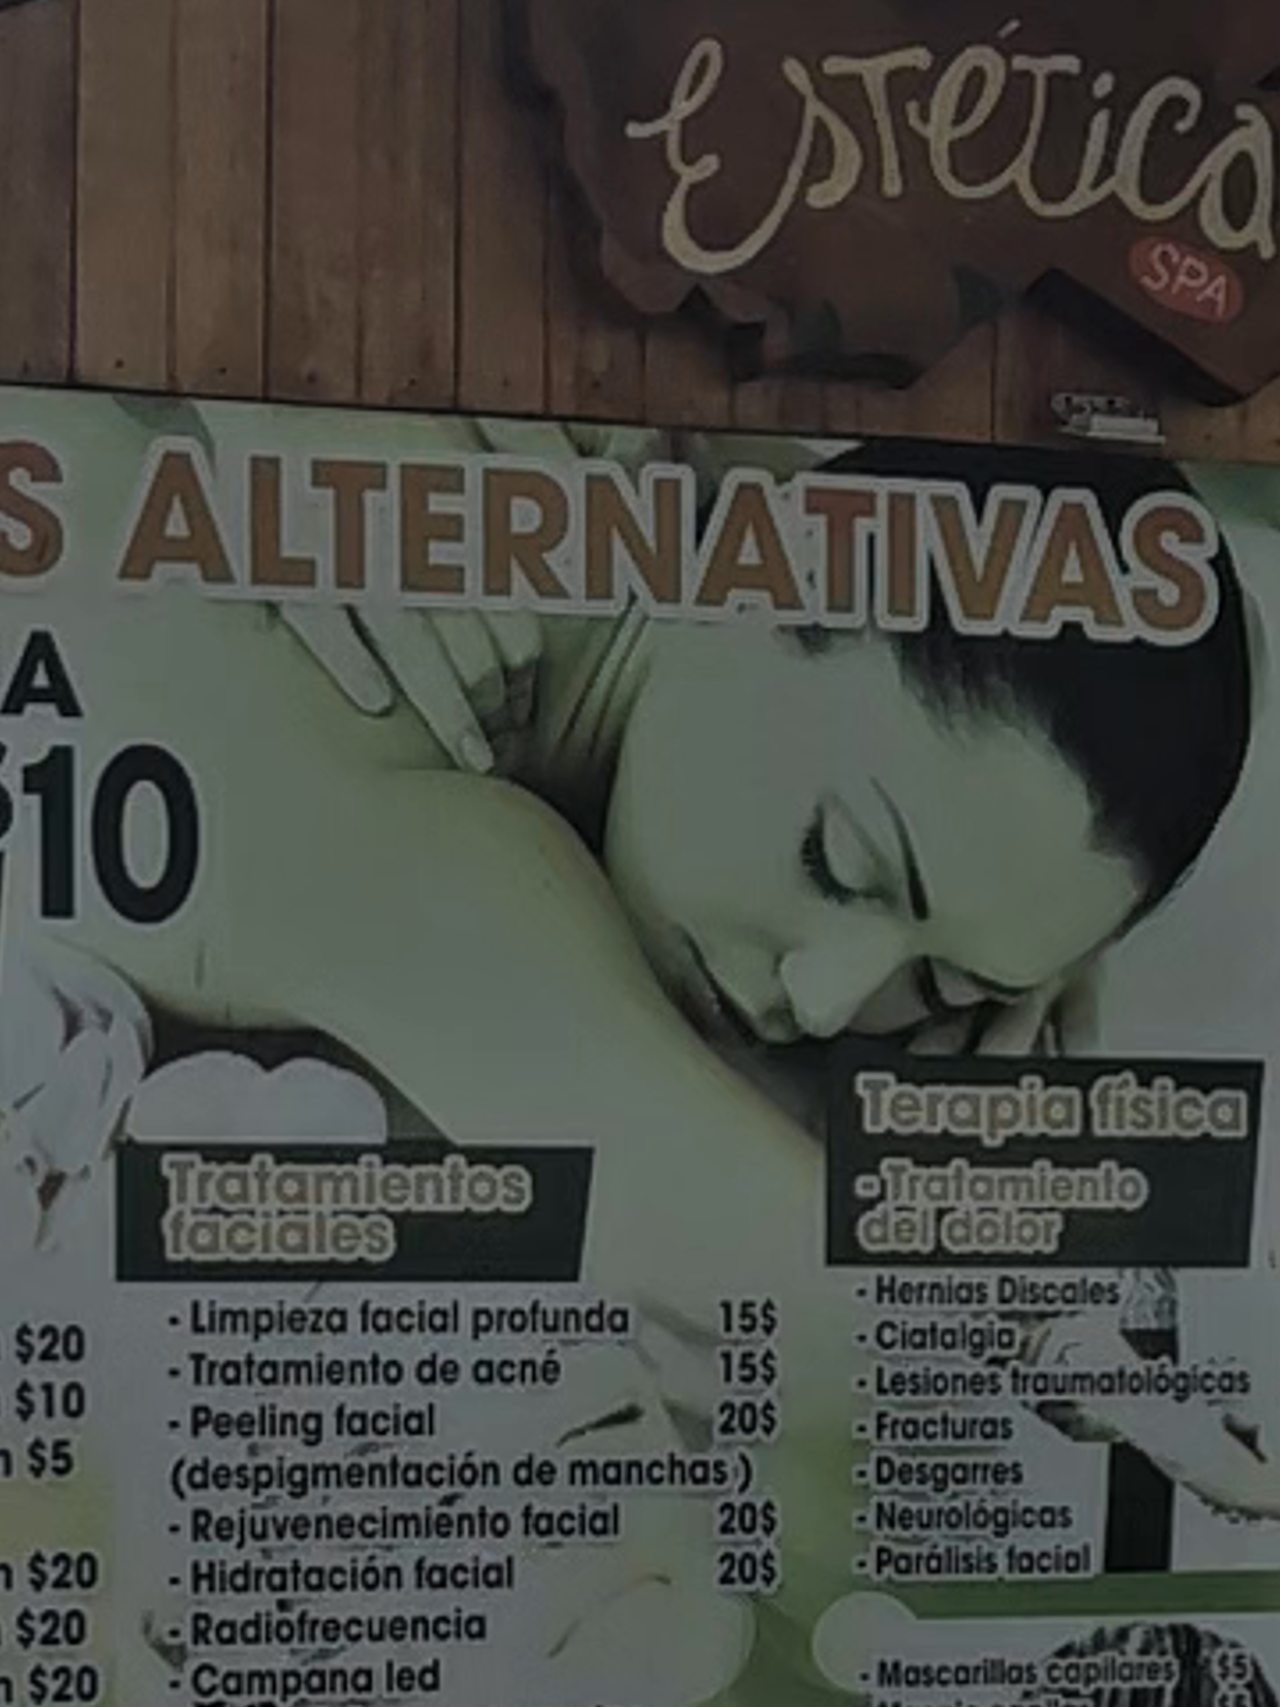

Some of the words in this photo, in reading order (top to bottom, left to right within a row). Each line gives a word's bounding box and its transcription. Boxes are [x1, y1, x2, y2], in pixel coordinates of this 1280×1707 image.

[120, 449, 1220, 631] ALTERNATIVAS
[860, 1078, 1077, 1141] Terapia
[1094, 1075, 1243, 1132] física
[167, 1159, 527, 1208] Tratamientos
[885, 1162, 1145, 1204] Tratamiento
[167, 1215, 392, 1258] faciales
[861, 1210, 931, 1248] del
[943, 1210, 1059, 1248] dolor
[876, 1275, 987, 1304] Hernias
[998, 1275, 1120, 1305] Discales
[191, 1300, 347, 1342] Limpieza
[360, 1300, 458, 1334] facial
[472, 1300, 628, 1340] profunda
[721, 1299, 776, 1336] 15$
[875, 1321, 1015, 1359] Ciatalgia
[16, 1324, 84, 1365] $20
[190, 1353, 403, 1386] Tratamiento
[416, 1353, 459, 1385] de
[472, 1349, 560, 1385] acné
[721, 1349, 776, 1386] 15$
[876, 1366, 1002, 1396] Lesiones
[1010, 1364, 1250, 1401] traumatológicas
[16, 1381, 84, 1422] $10
[191, 1404, 322, 1447] Peeling
[336, 1403, 434, 1436] facial
[720, 1400, 776, 1435] 20$
[876, 1411, 1012, 1441] Fracturas
[28, 1439, 73, 1478] $5
[513, 1454, 556, 1486] de
[876, 1456, 1023, 1495] Desgarres
[192, 1506, 510, 1551] Rejuvenecimiento
[522, 1503, 618, 1537] facial
[720, 1501, 776, 1536] 20$
[876, 1498, 1072, 1537] Neurológicas
[28, 1552, 97, 1592] $20
[876, 1544, 997, 1574] Parálisis
[1006, 1545, 1090, 1573] facial
[192, 1608, 486, 1645] Radiofrecuencia
[191, 1660, 372, 1702] Campana
[387, 1659, 439, 1692] led
[879, 1660, 1037, 1686] Mascarillas
[1047, 1654, 1177, 1686] capilares
[1218, 1651, 1247, 1681] $5
